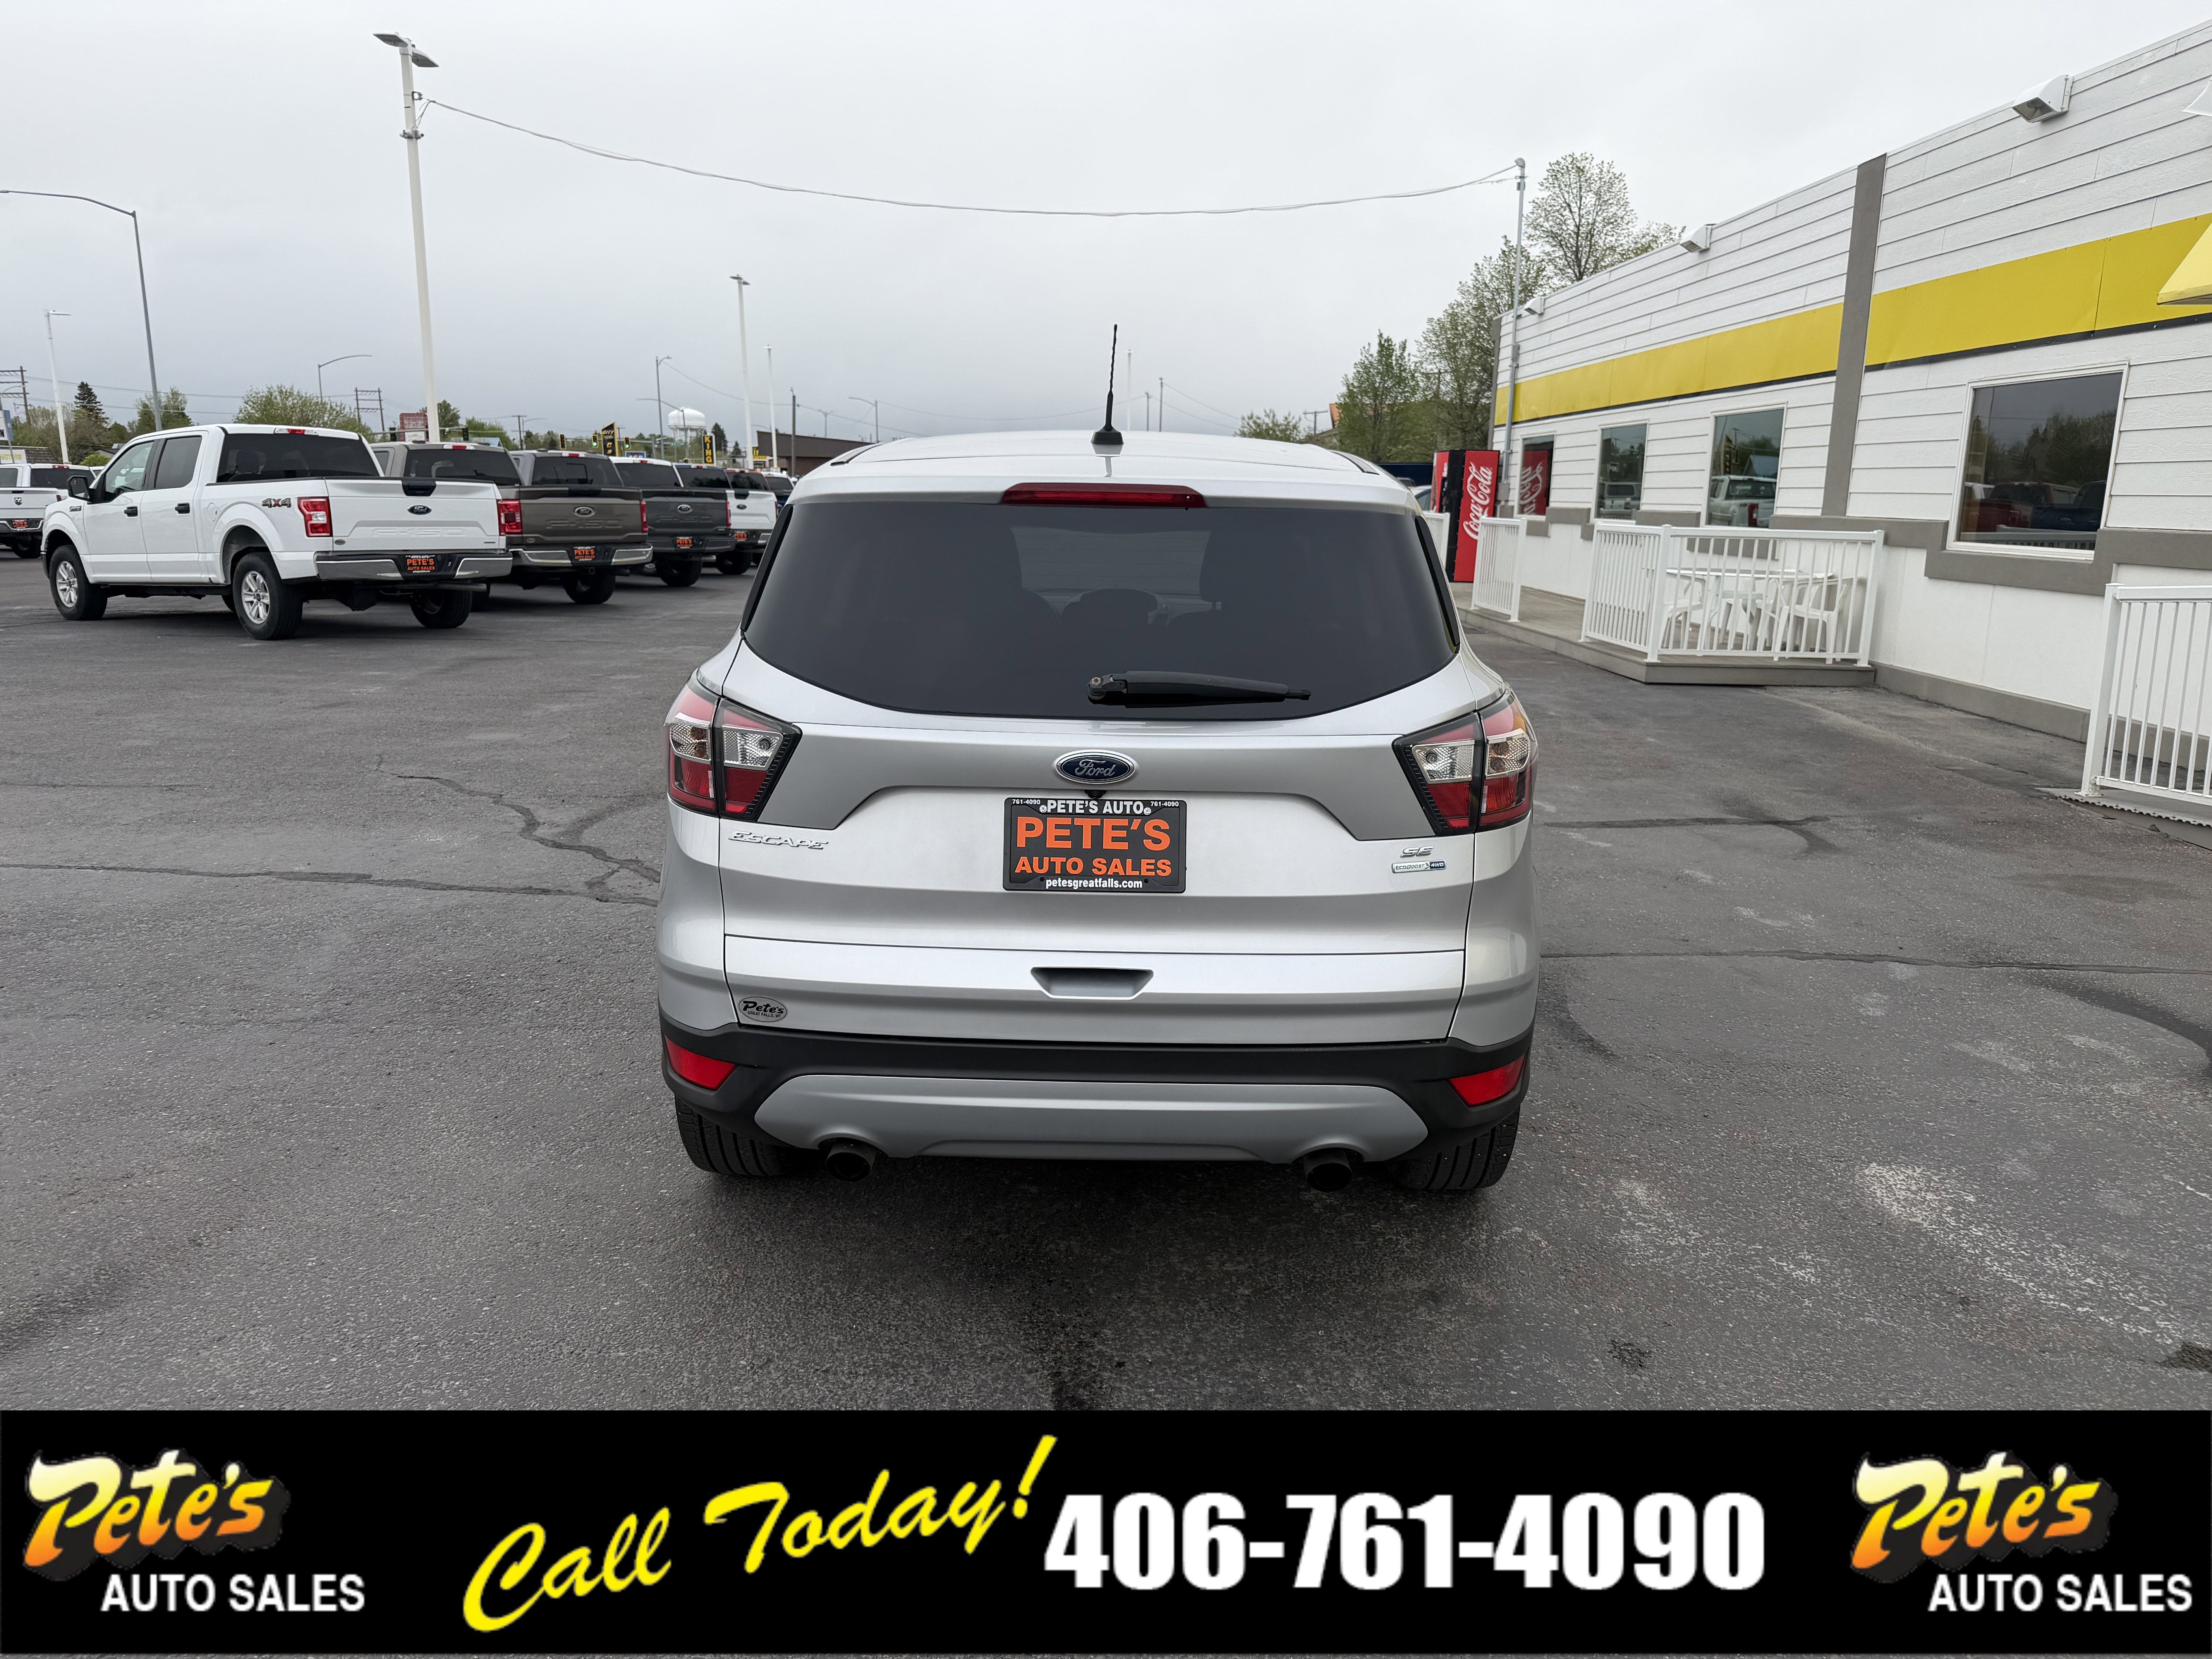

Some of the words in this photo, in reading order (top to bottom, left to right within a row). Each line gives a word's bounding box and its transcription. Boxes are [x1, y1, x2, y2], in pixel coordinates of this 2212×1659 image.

[704, 436, 713, 463] KING
[1463, 462, 1492, 540] Coca-Cola
[1075, 759, 1116, 776] Ford
[1047, 800, 1099, 813] PETE'S
[1103, 801, 1144, 814] AUTO
[728, 830, 829, 850] ESCAPE
[1017, 816, 1171, 851] PETE'S
[1400, 845, 1434, 858] SE
[1015, 857, 1084, 874] AUTO
[1092, 858, 1172, 876] SALES
[1046, 878, 1143, 890] petesgreatfalls.com
[743, 1000, 784, 1014] Pete's
